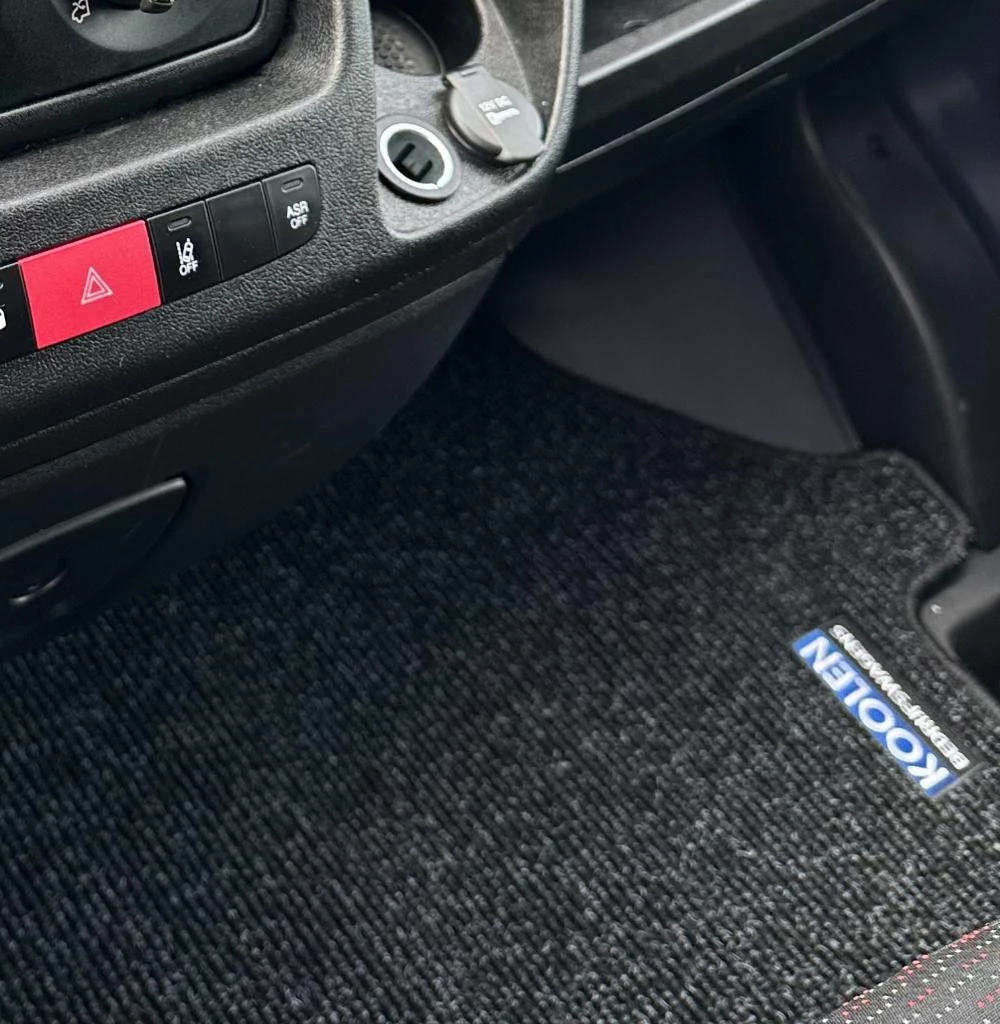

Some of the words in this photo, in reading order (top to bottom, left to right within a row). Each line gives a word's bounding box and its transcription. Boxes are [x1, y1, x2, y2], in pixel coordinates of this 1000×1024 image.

[286, 200, 310, 219] ASR
[289, 214, 309, 230] OFF
[178, 259, 199, 277] OFF
[828, 624, 970, 771] BEDRIJFSWAGENS
[799, 635, 951, 790] KOOLEN
